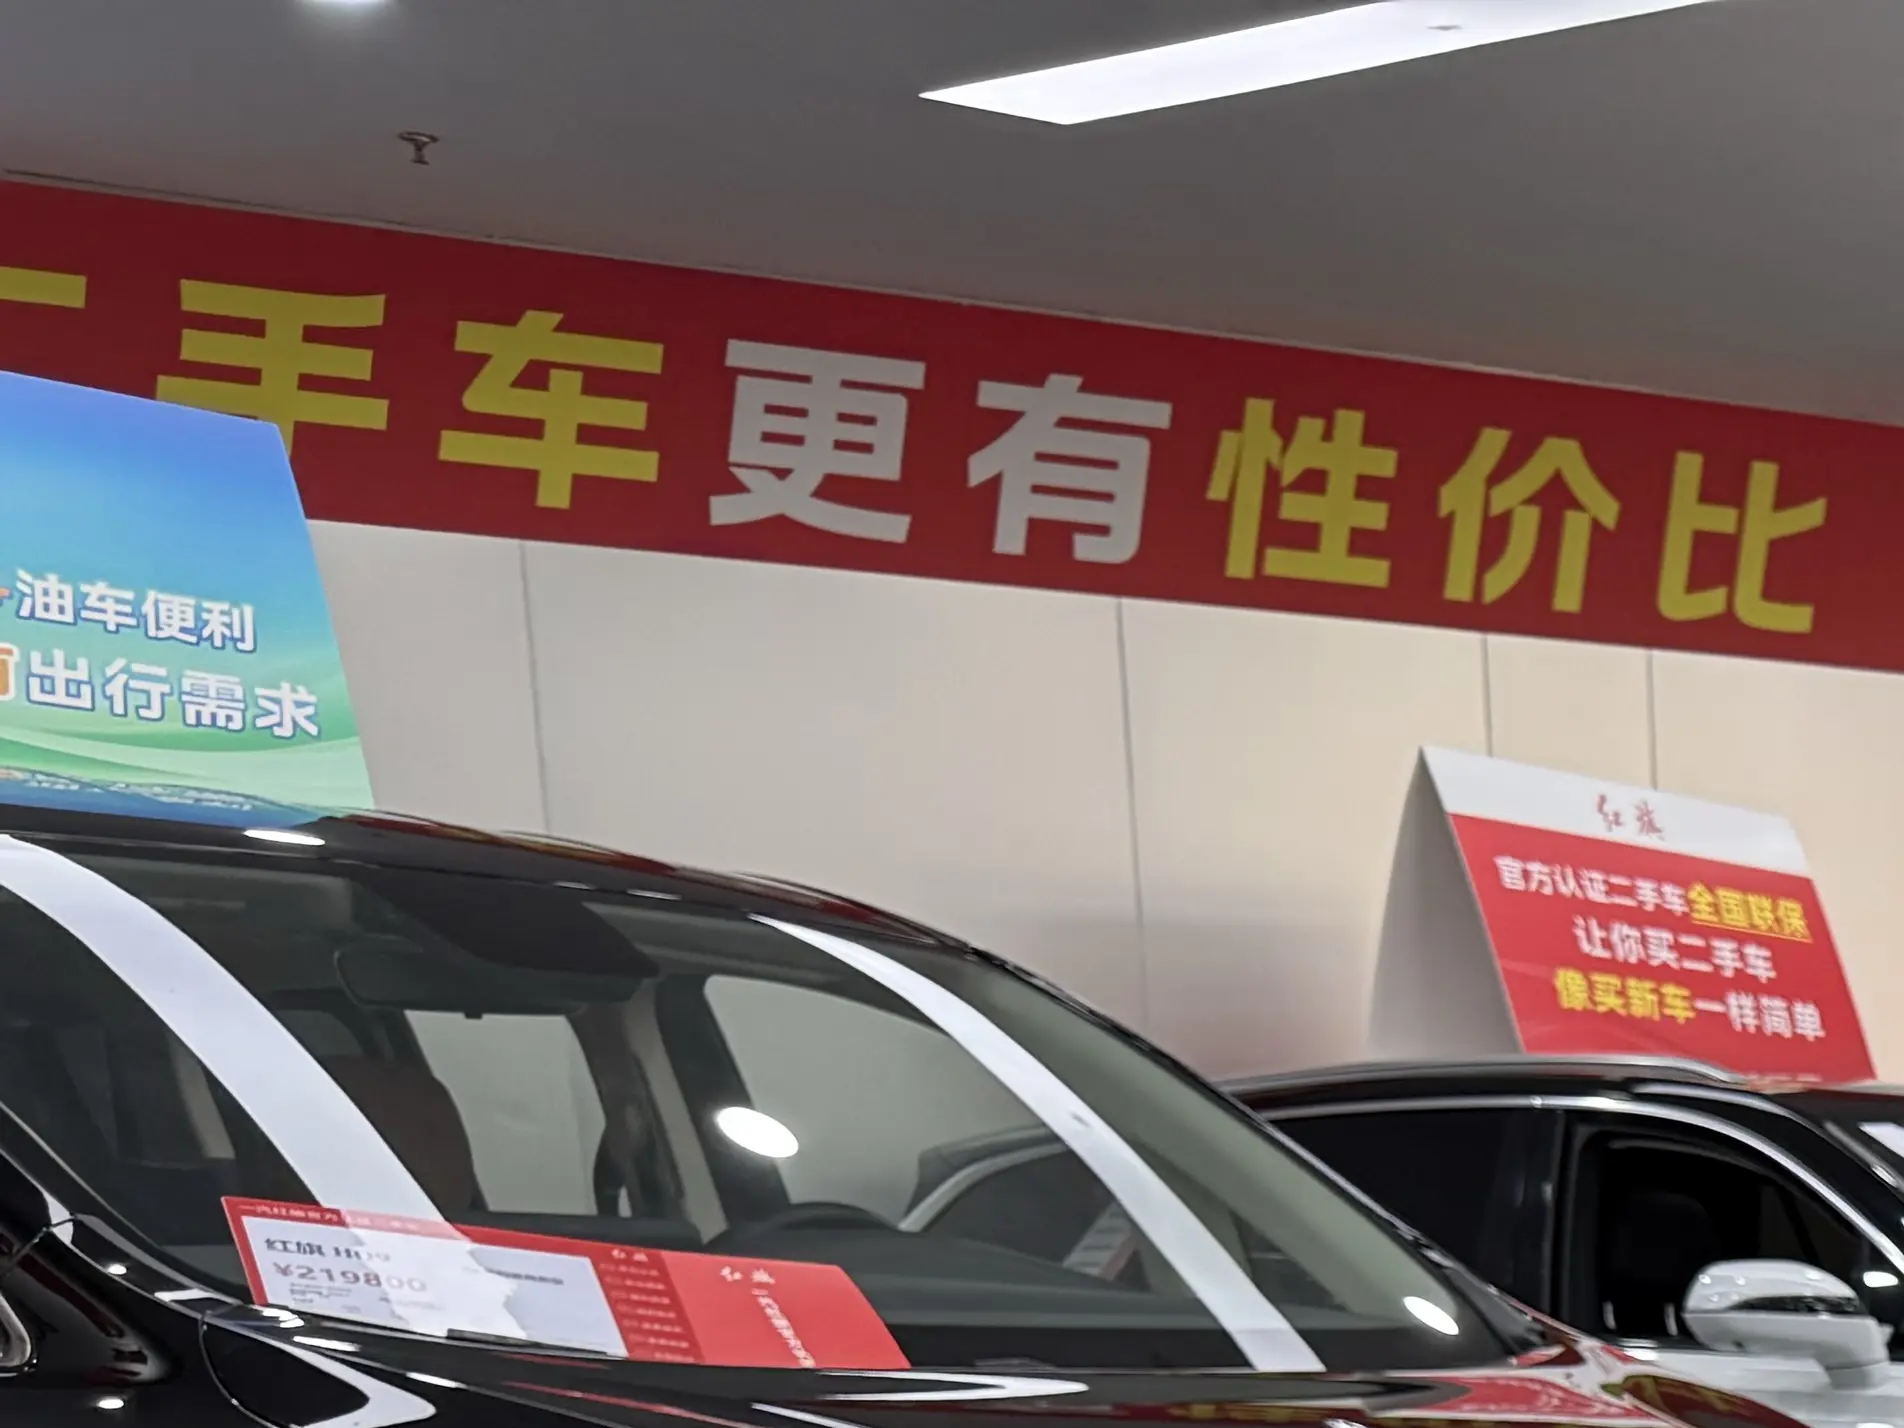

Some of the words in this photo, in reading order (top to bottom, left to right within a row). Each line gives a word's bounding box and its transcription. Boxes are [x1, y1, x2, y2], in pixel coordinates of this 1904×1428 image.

[0, 568, 256, 652] 油车便利
[1493, 856, 1809, 938] 官方认证二手车全国联保
[1572, 915, 1776, 983] 让你买二手车
[1553, 967, 1826, 1041] 像买新车一样简单
